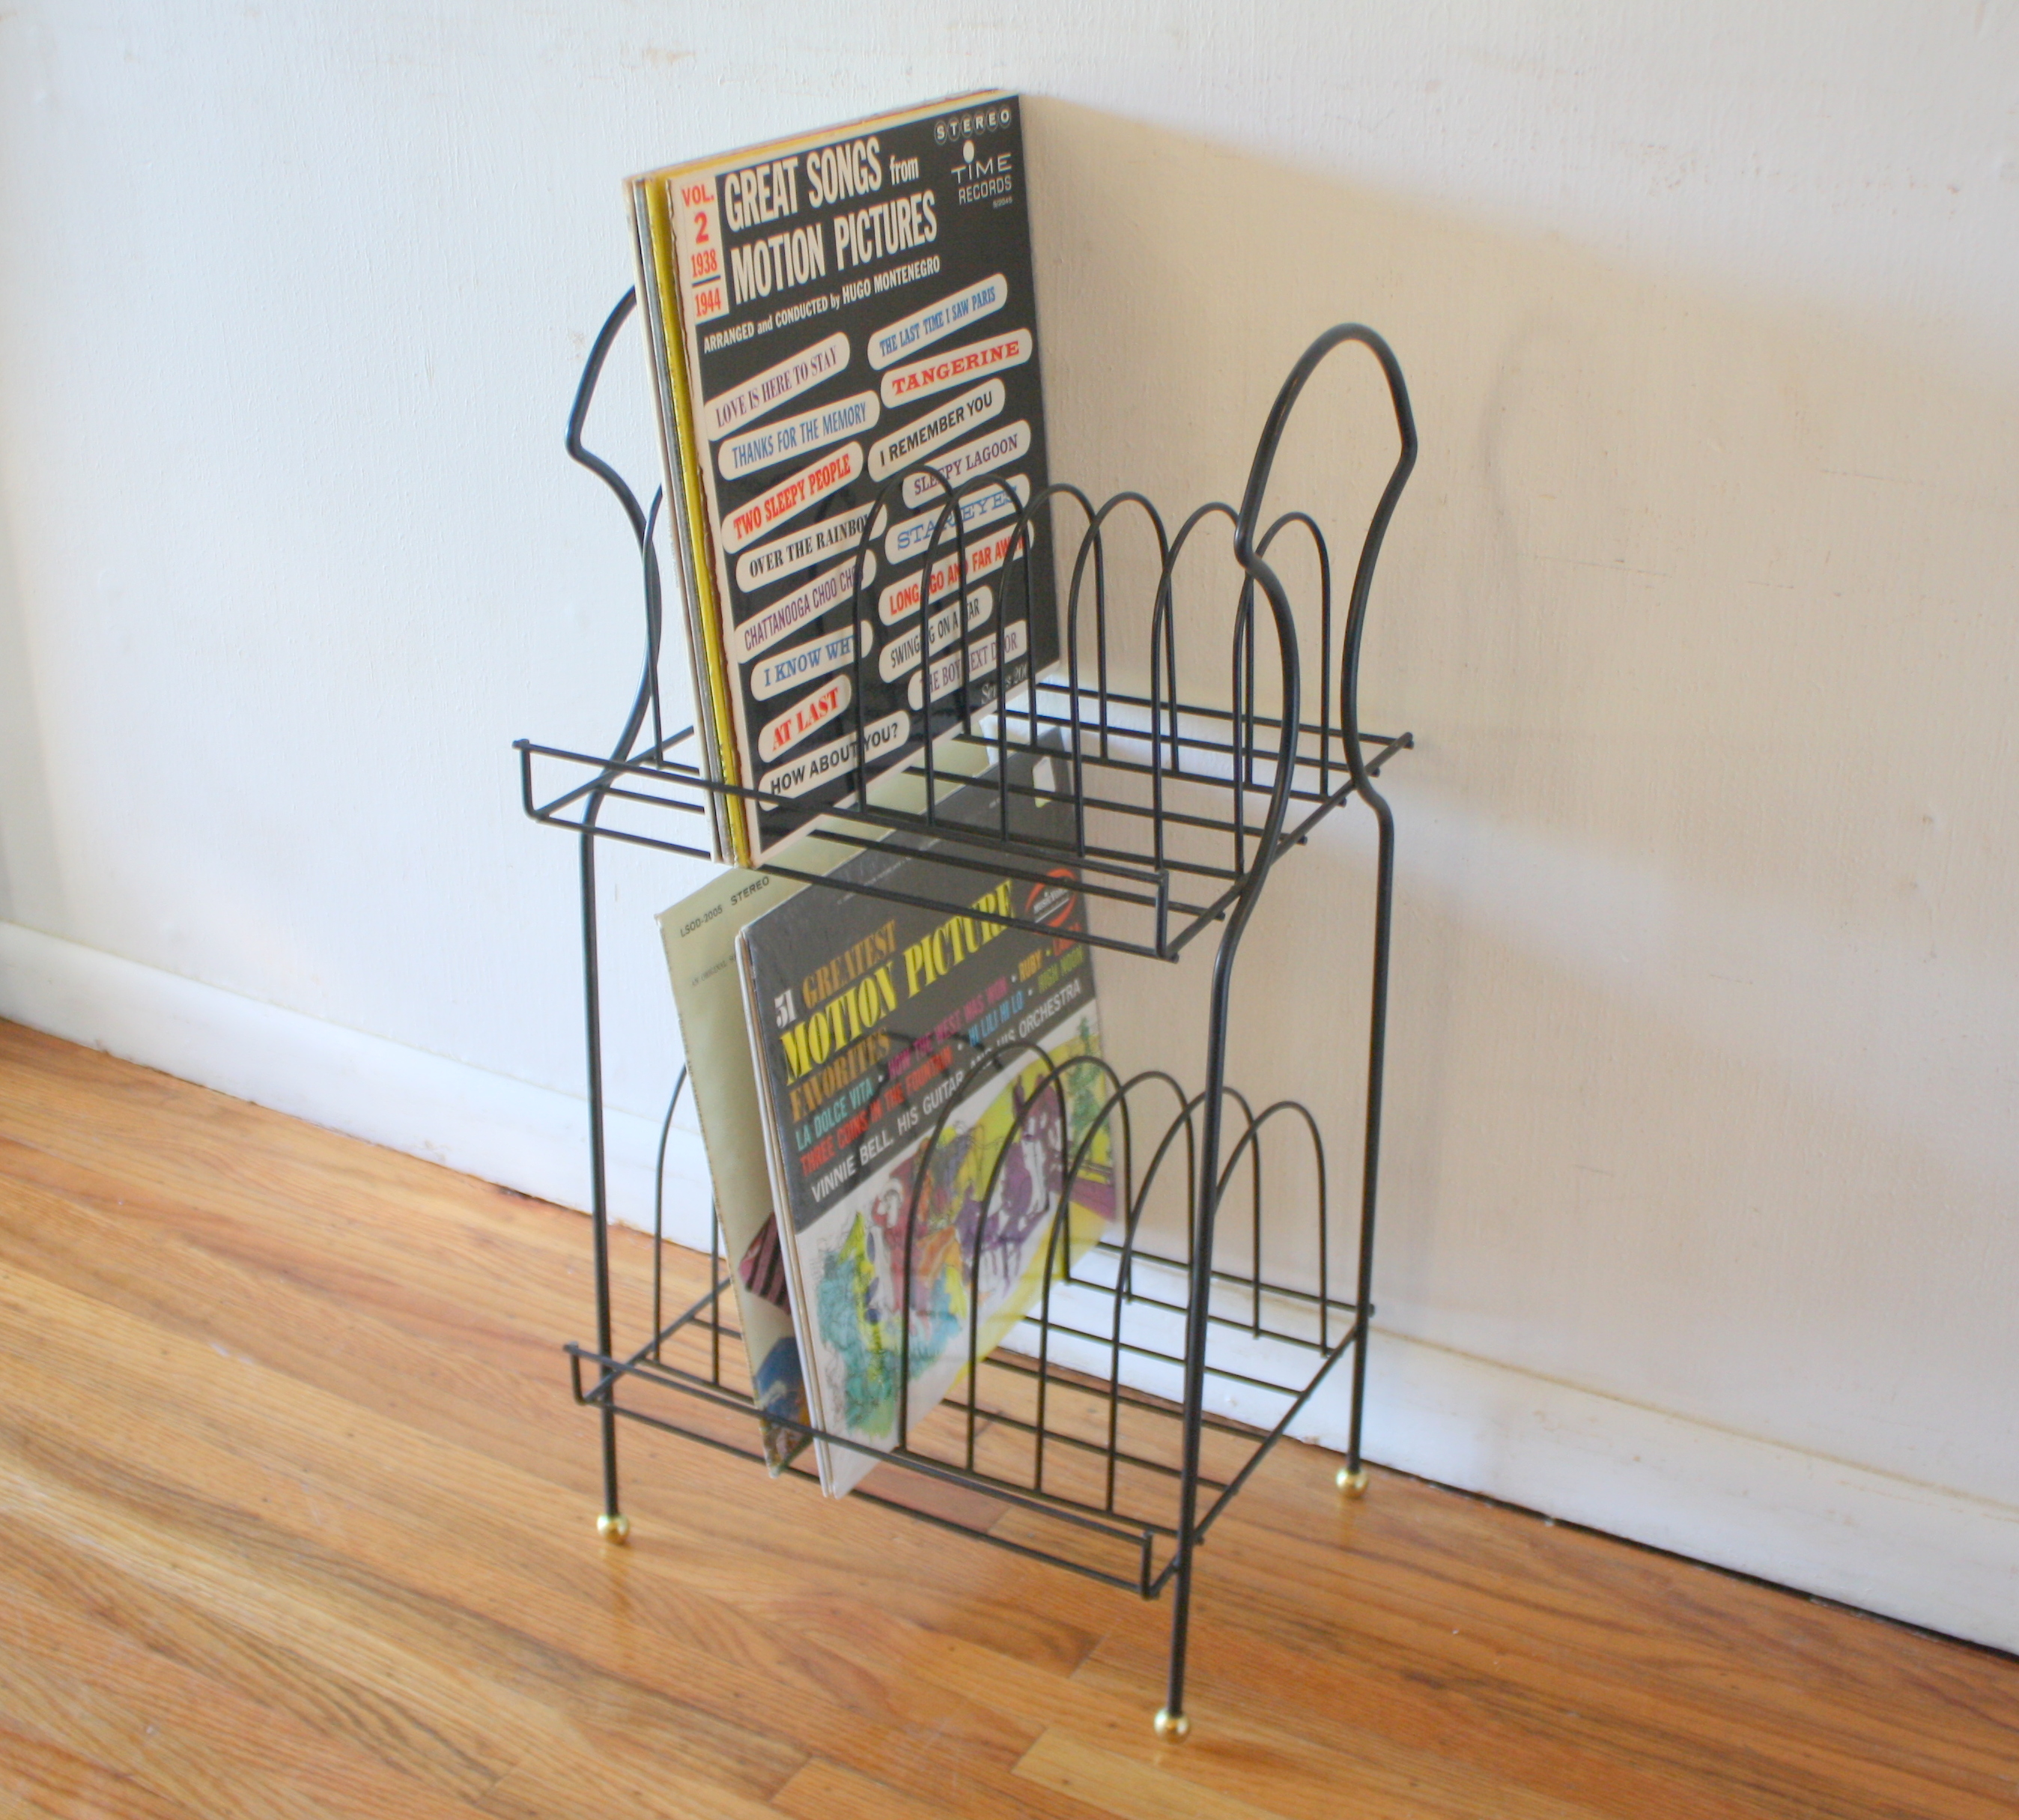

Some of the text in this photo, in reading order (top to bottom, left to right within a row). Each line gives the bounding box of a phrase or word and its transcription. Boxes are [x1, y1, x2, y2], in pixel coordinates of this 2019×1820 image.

[935, 108, 1011, 142] STEREO
[681, 184, 714, 207] VOL.
[724, 136, 919, 232] GREAT SONGS from
[950, 153, 1012, 184] TIME
[958, 175, 1012, 205] RECORDS
[694, 211, 709, 244] 2
[730, 189, 938, 305] MOTION PICTURES
[690, 249, 717, 278] 1938
[694, 288, 720, 318] 1944
[703, 255, 941, 354] ARRANGED and CONDUCTED by HUGO MONTENEGRO
[879, 285, 996, 357] THE LAST TIME I SAW PARIS
[715, 345, 838, 428] LOVE IS HERE TO STAY
[892, 341, 1020, 395] TANGERINE
[732, 401, 866, 470] THANKS FOR THE MEMORY
[880, 391, 993, 467] I REMEMBER YOU
[965, 434, 1018, 470] LAGOON
[733, 453, 851, 540] TWO SLEEPY PEOPLE
[750, 548, 784, 578] OVER
[786, 536, 813, 563] THE
[889, 583, 920, 616] LONG
[927, 571, 945, 596] GO
[971, 546, 992, 572] FAR
[744, 565, 856, 652] CHATTANOOGA CHOO CHO
[890, 597, 980, 669] SWINGG ON A AR
[764, 636, 854, 688] I KNOW WH
[942, 659, 962, 688] BOY
[968, 645, 989, 673] EXT
[991, 631, 1018, 660] DOR
[772, 687, 839, 752] AT LAST
[770, 723, 898, 795] HOW ABOUT YOU?
[680, 876, 770, 938] LSOD-2005 STEREO
[774, 919, 896, 1029] 51 GREATEST
[780, 878, 1015, 1085] MOTION PICTURE
[789, 1026, 891, 1123] FAVORITES
[811, 1155, 856, 1203] VINNIE
[859, 1129, 895, 1165] BELL,
[897, 1107, 919, 1136] HIS
[923, 1070, 965, 1115] GUITAR
[1018, 977, 1081, 1039] ORCHESTRA
[795, 1124, 813, 1152] LA
[813, 1096, 848, 1138] DOLCE
[848, 1077, 875, 1110] VITA
[800, 1135, 837, 1177] THREE
